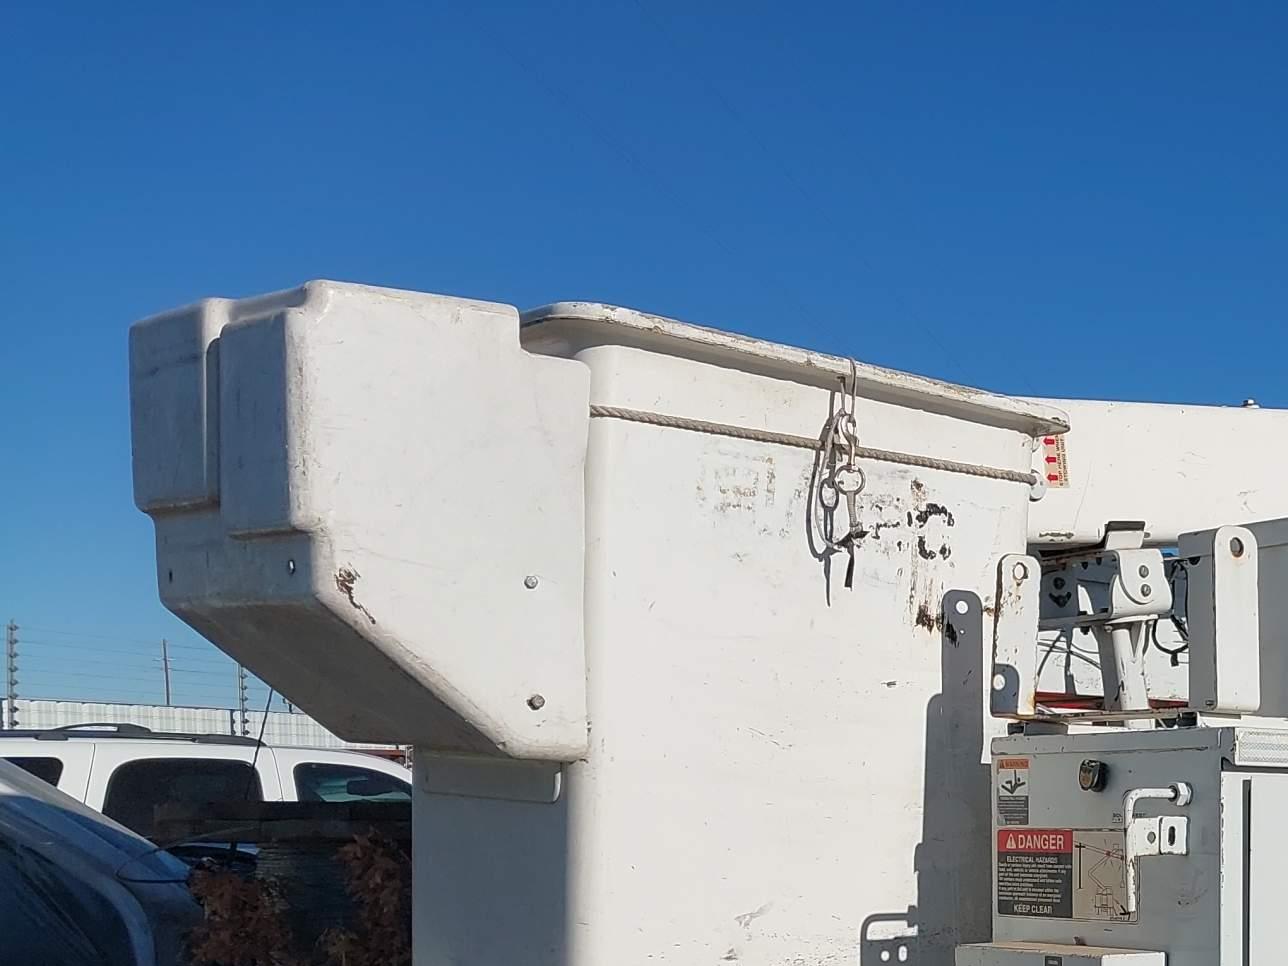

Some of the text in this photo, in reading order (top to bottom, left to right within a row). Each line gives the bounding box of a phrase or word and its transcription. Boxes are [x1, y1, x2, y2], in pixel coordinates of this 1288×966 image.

[1018, 834, 1064, 849] DANGER
[1014, 904, 1053, 914] KEEP CLEAR
